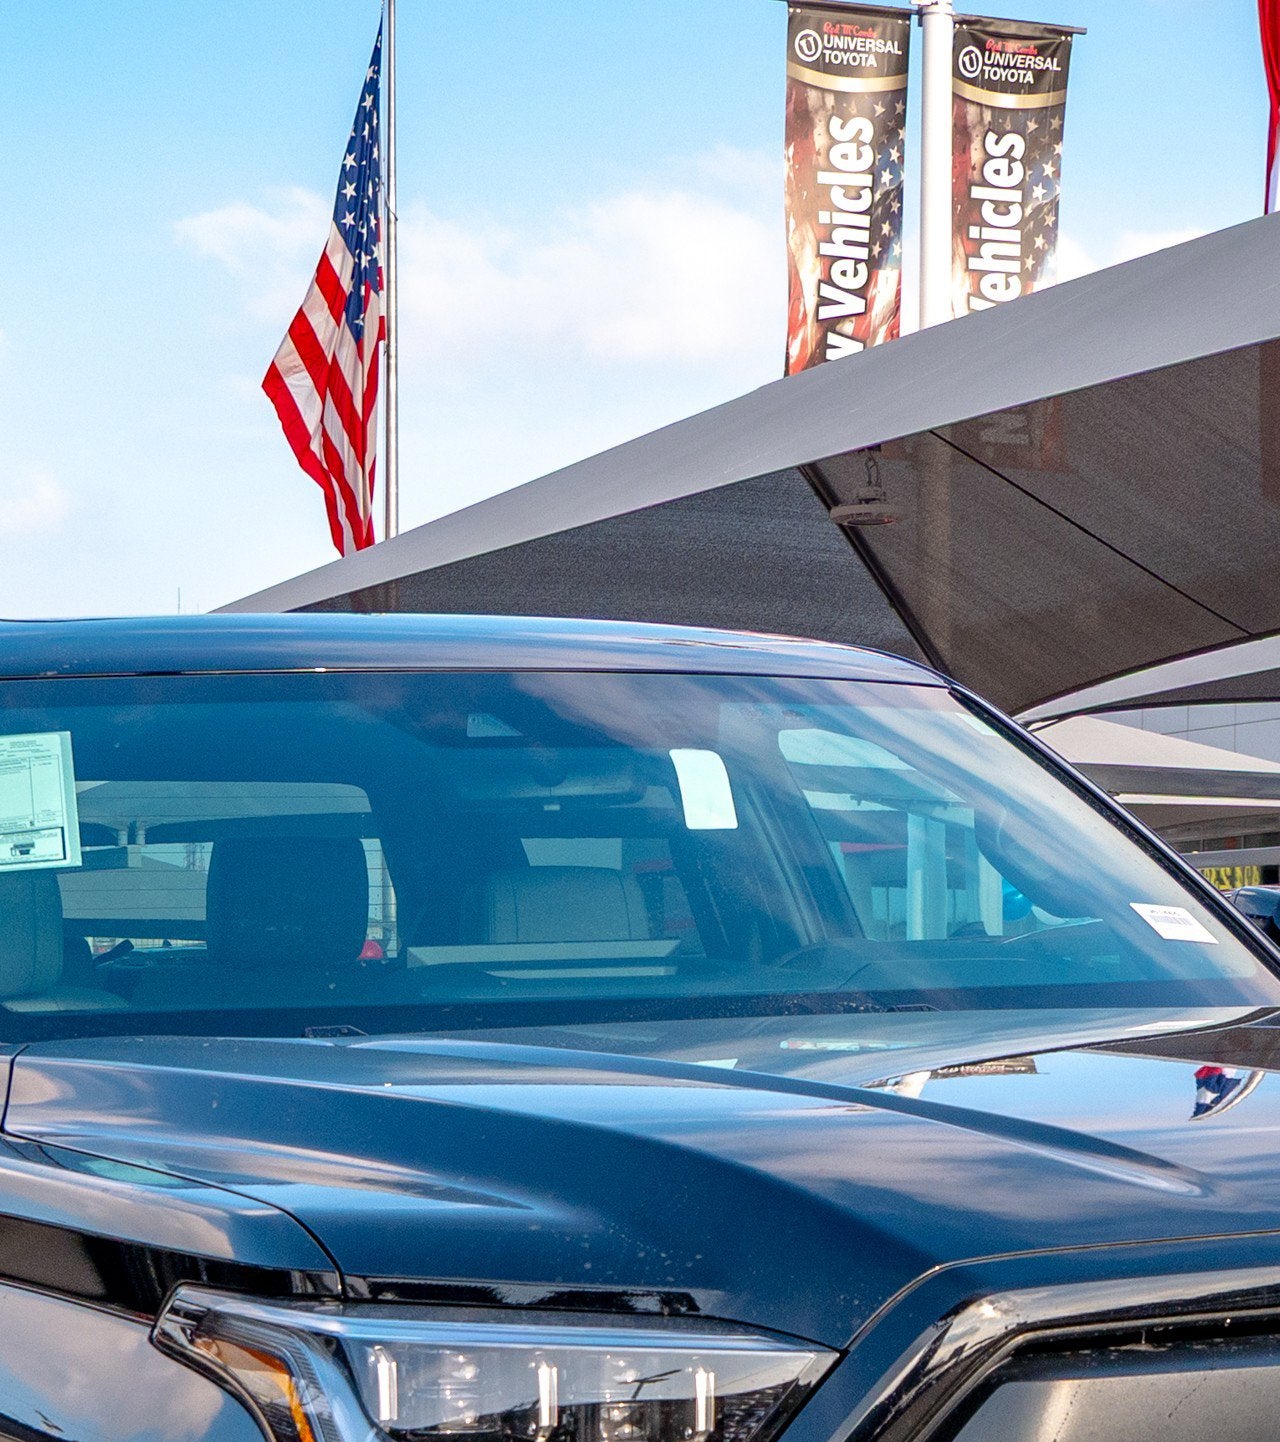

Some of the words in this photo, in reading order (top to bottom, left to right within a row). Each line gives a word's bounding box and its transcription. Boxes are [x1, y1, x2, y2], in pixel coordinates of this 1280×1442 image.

[823, 34, 902, 55] UNIVERSAL
[823, 49, 877, 67] TOYOTA
[984, 51, 1061, 71] UNIVERSAL
[983, 66, 1034, 84] TOYOTA
[817, 115, 874, 321] Vehicles
